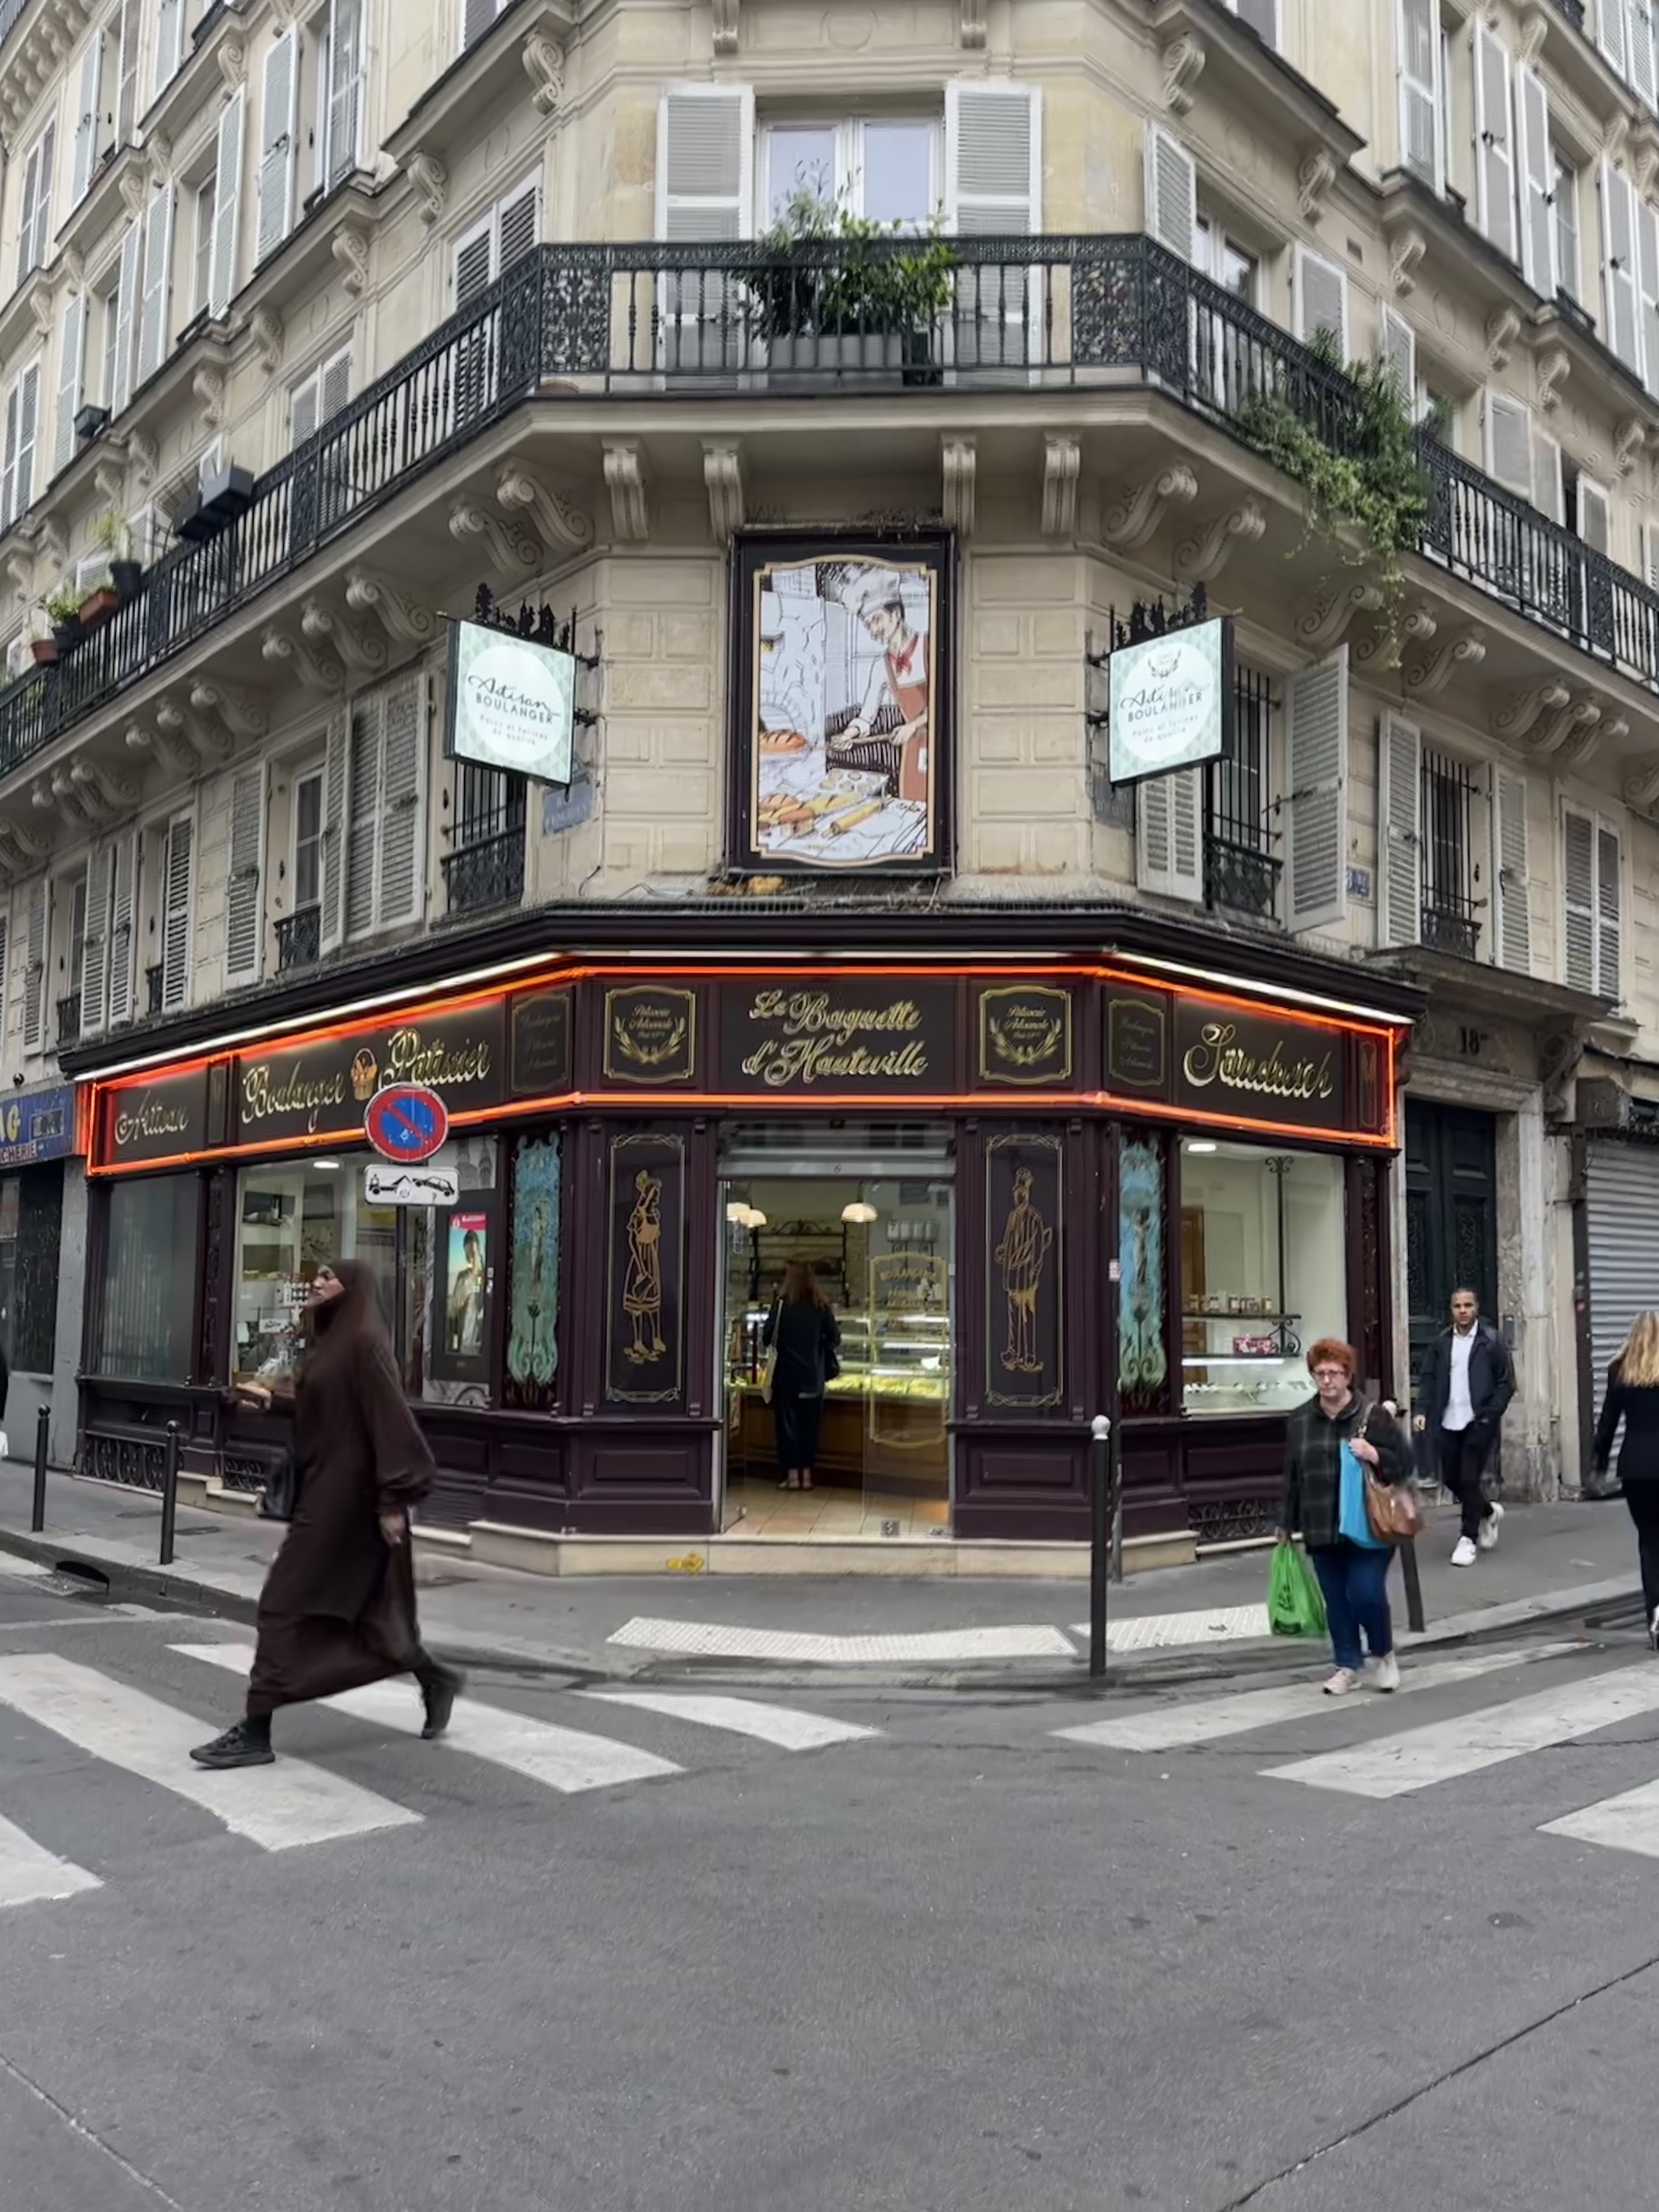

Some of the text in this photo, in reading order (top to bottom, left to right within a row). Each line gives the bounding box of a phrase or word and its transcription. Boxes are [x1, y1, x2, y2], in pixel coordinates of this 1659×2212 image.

[467, 674, 561, 717] Artisan
[476, 692, 552, 724] BOULANGER
[749, 989, 922, 1046] La Baguette
[741, 1033, 929, 1087] d'Hauteville
[1183, 1022, 1333, 1099] Sandwich
[241, 1060, 346, 1133] Boulanger
